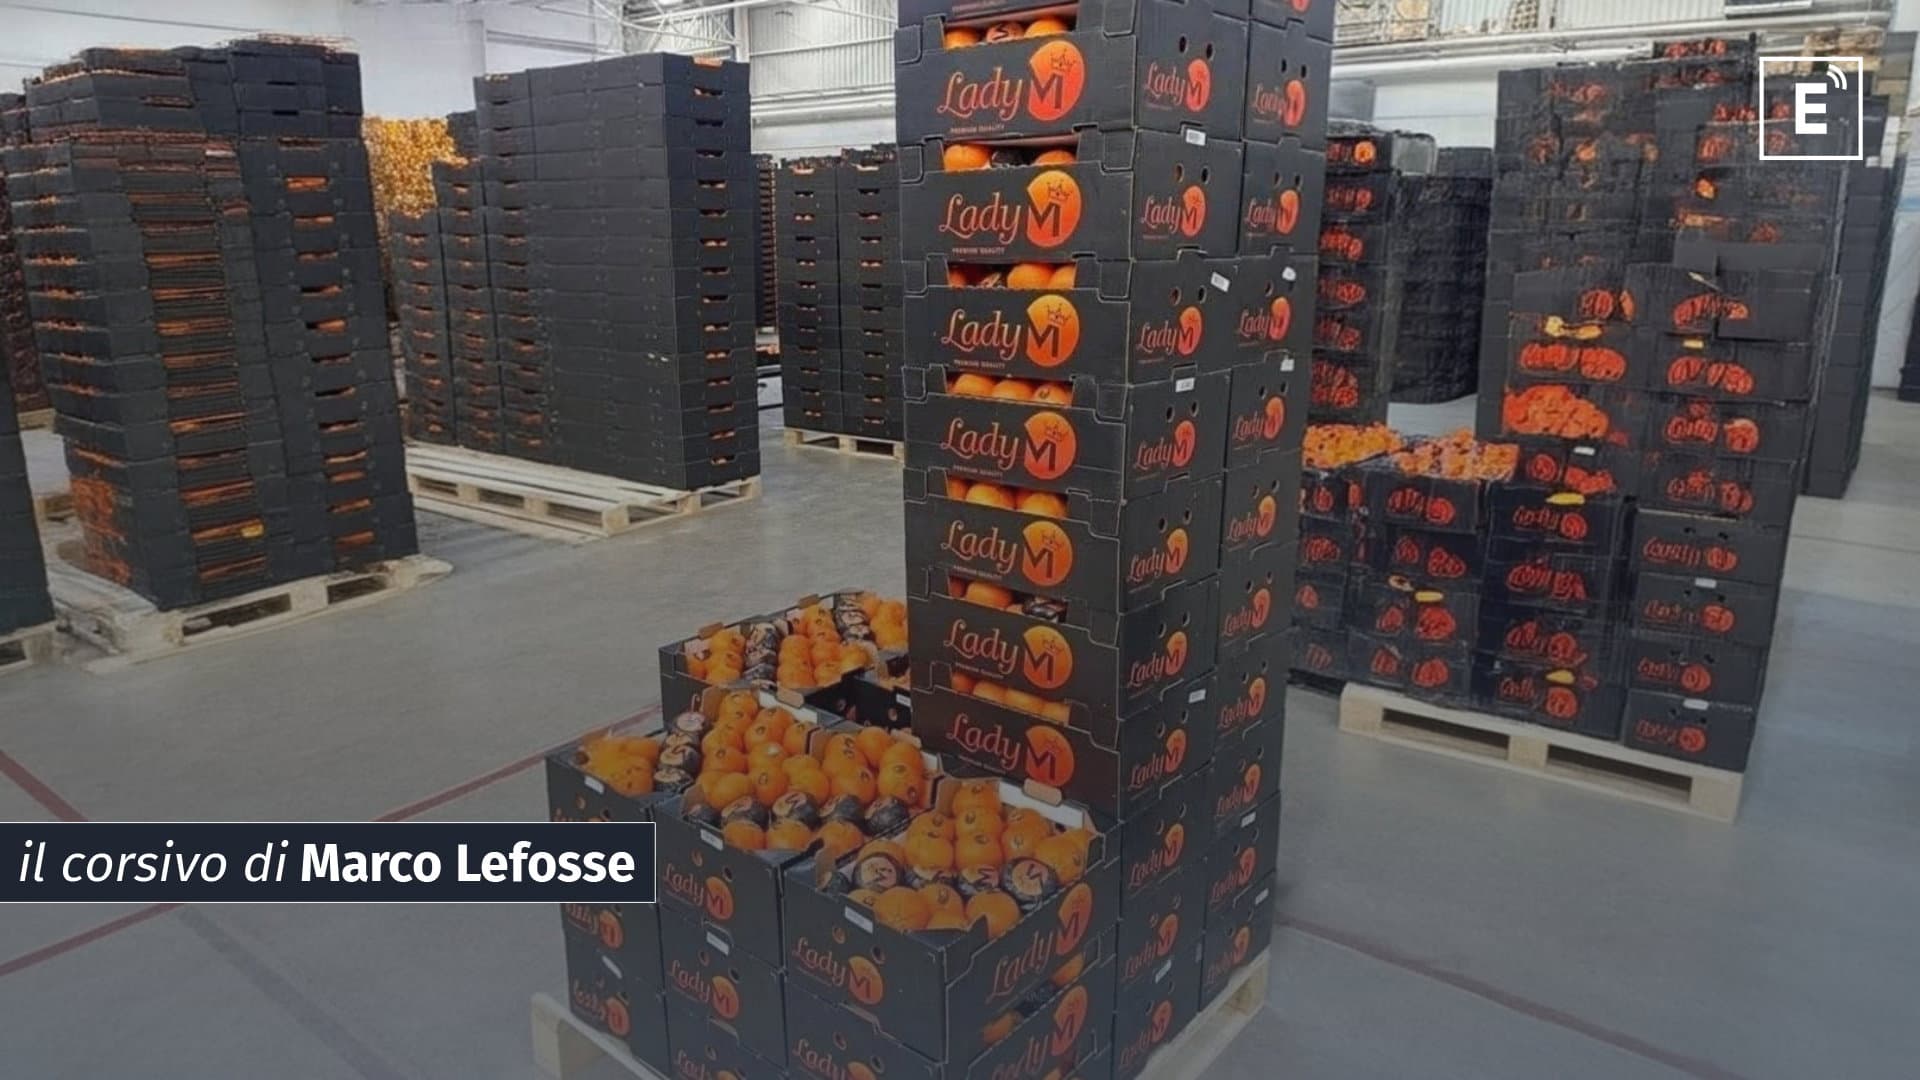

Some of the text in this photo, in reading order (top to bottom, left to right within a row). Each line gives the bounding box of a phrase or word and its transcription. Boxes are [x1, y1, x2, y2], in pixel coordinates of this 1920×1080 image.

[937, 67, 1023, 121] Lady
[1144, 62, 1186, 106] Lady
[938, 192, 1021, 245] Lady
[1141, 195, 1182, 235] Lady
[941, 308, 1021, 360] Lady
[1136, 320, 1178, 355] Lady
[941, 418, 1019, 471] Lady
[1134, 437, 1173, 471] Lady
[941, 519, 1018, 574] Lady
[1126, 547, 1166, 583] Lady
[943, 619, 1019, 675] Lady
[1127, 652, 1166, 688] Lady
[947, 713, 1022, 771] Lady
[1128, 754, 1166, 791] Lady
[663, 863, 705, 907] Lady
[668, 959, 711, 1004] Lady
[792, 936, 846, 988] Lady
[988, 930, 1053, 1000] Lady
